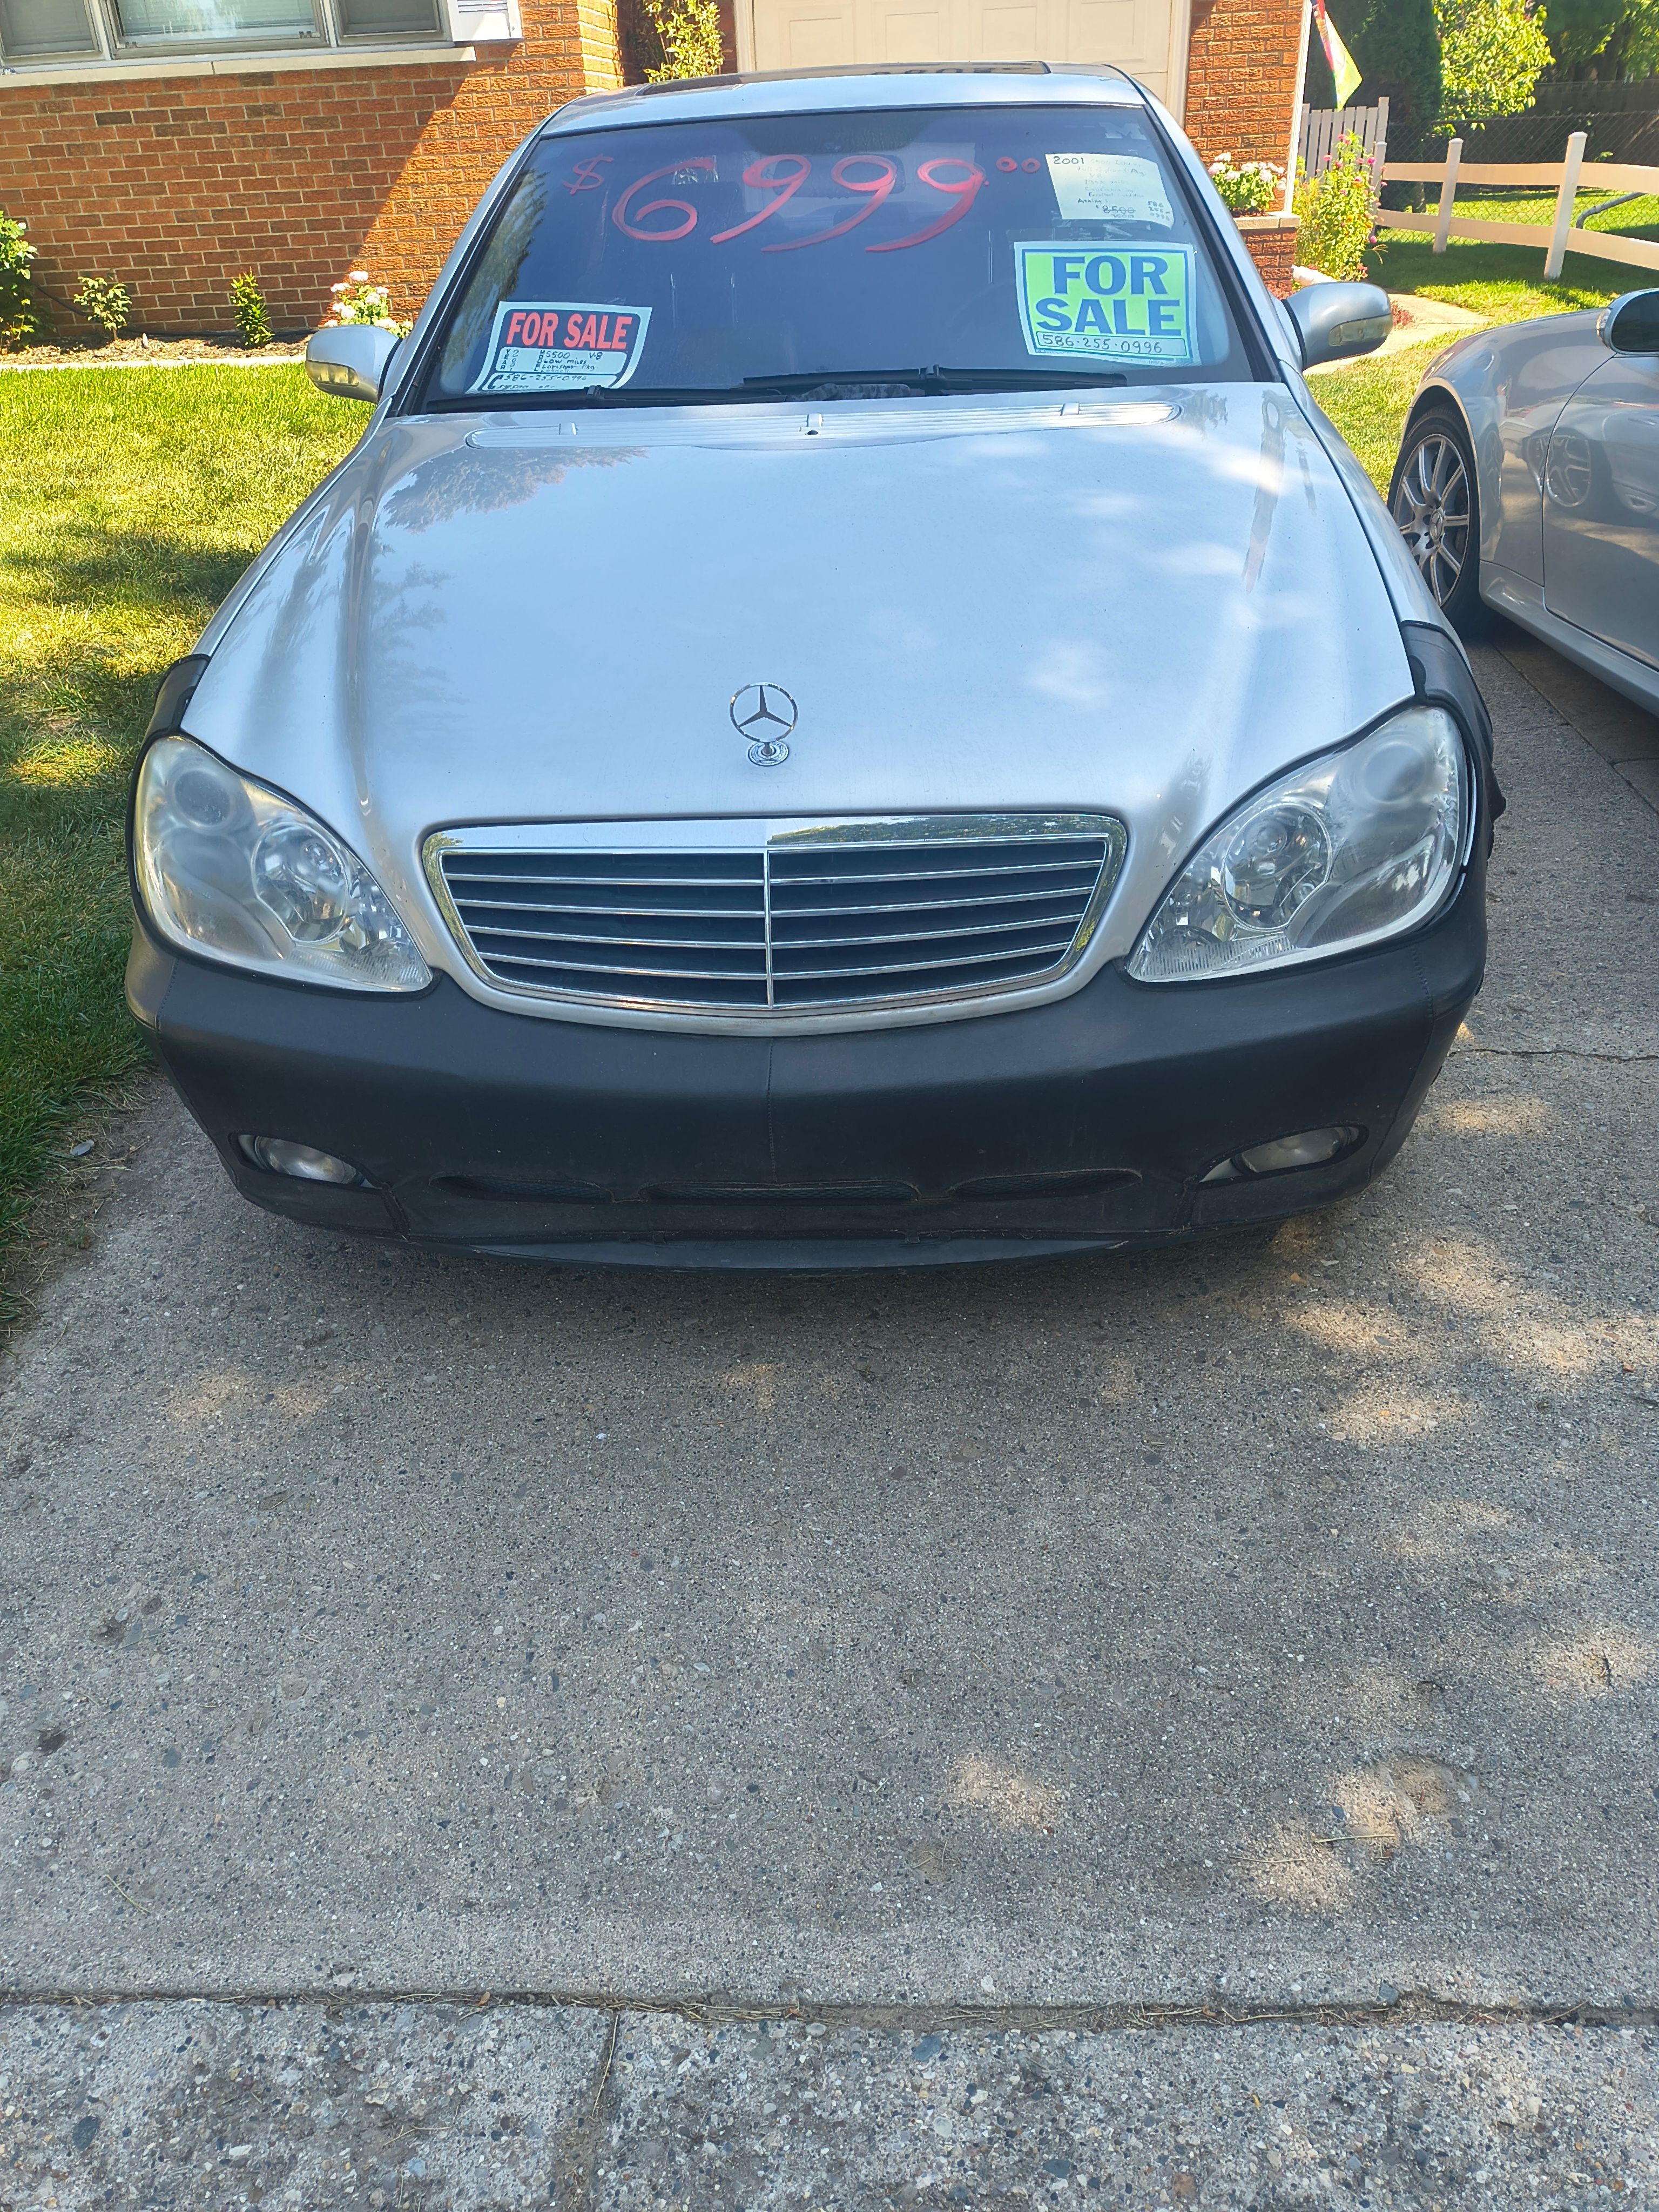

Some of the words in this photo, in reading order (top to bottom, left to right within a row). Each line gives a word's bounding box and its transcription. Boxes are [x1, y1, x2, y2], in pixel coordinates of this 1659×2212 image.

[1053, 156, 1084, 165] 2001
[1053, 255, 1169, 295] FOR
[506, 312, 558, 346] FOR
[563, 314, 633, 349] SALE
[1035, 297, 1182, 336] SALE
